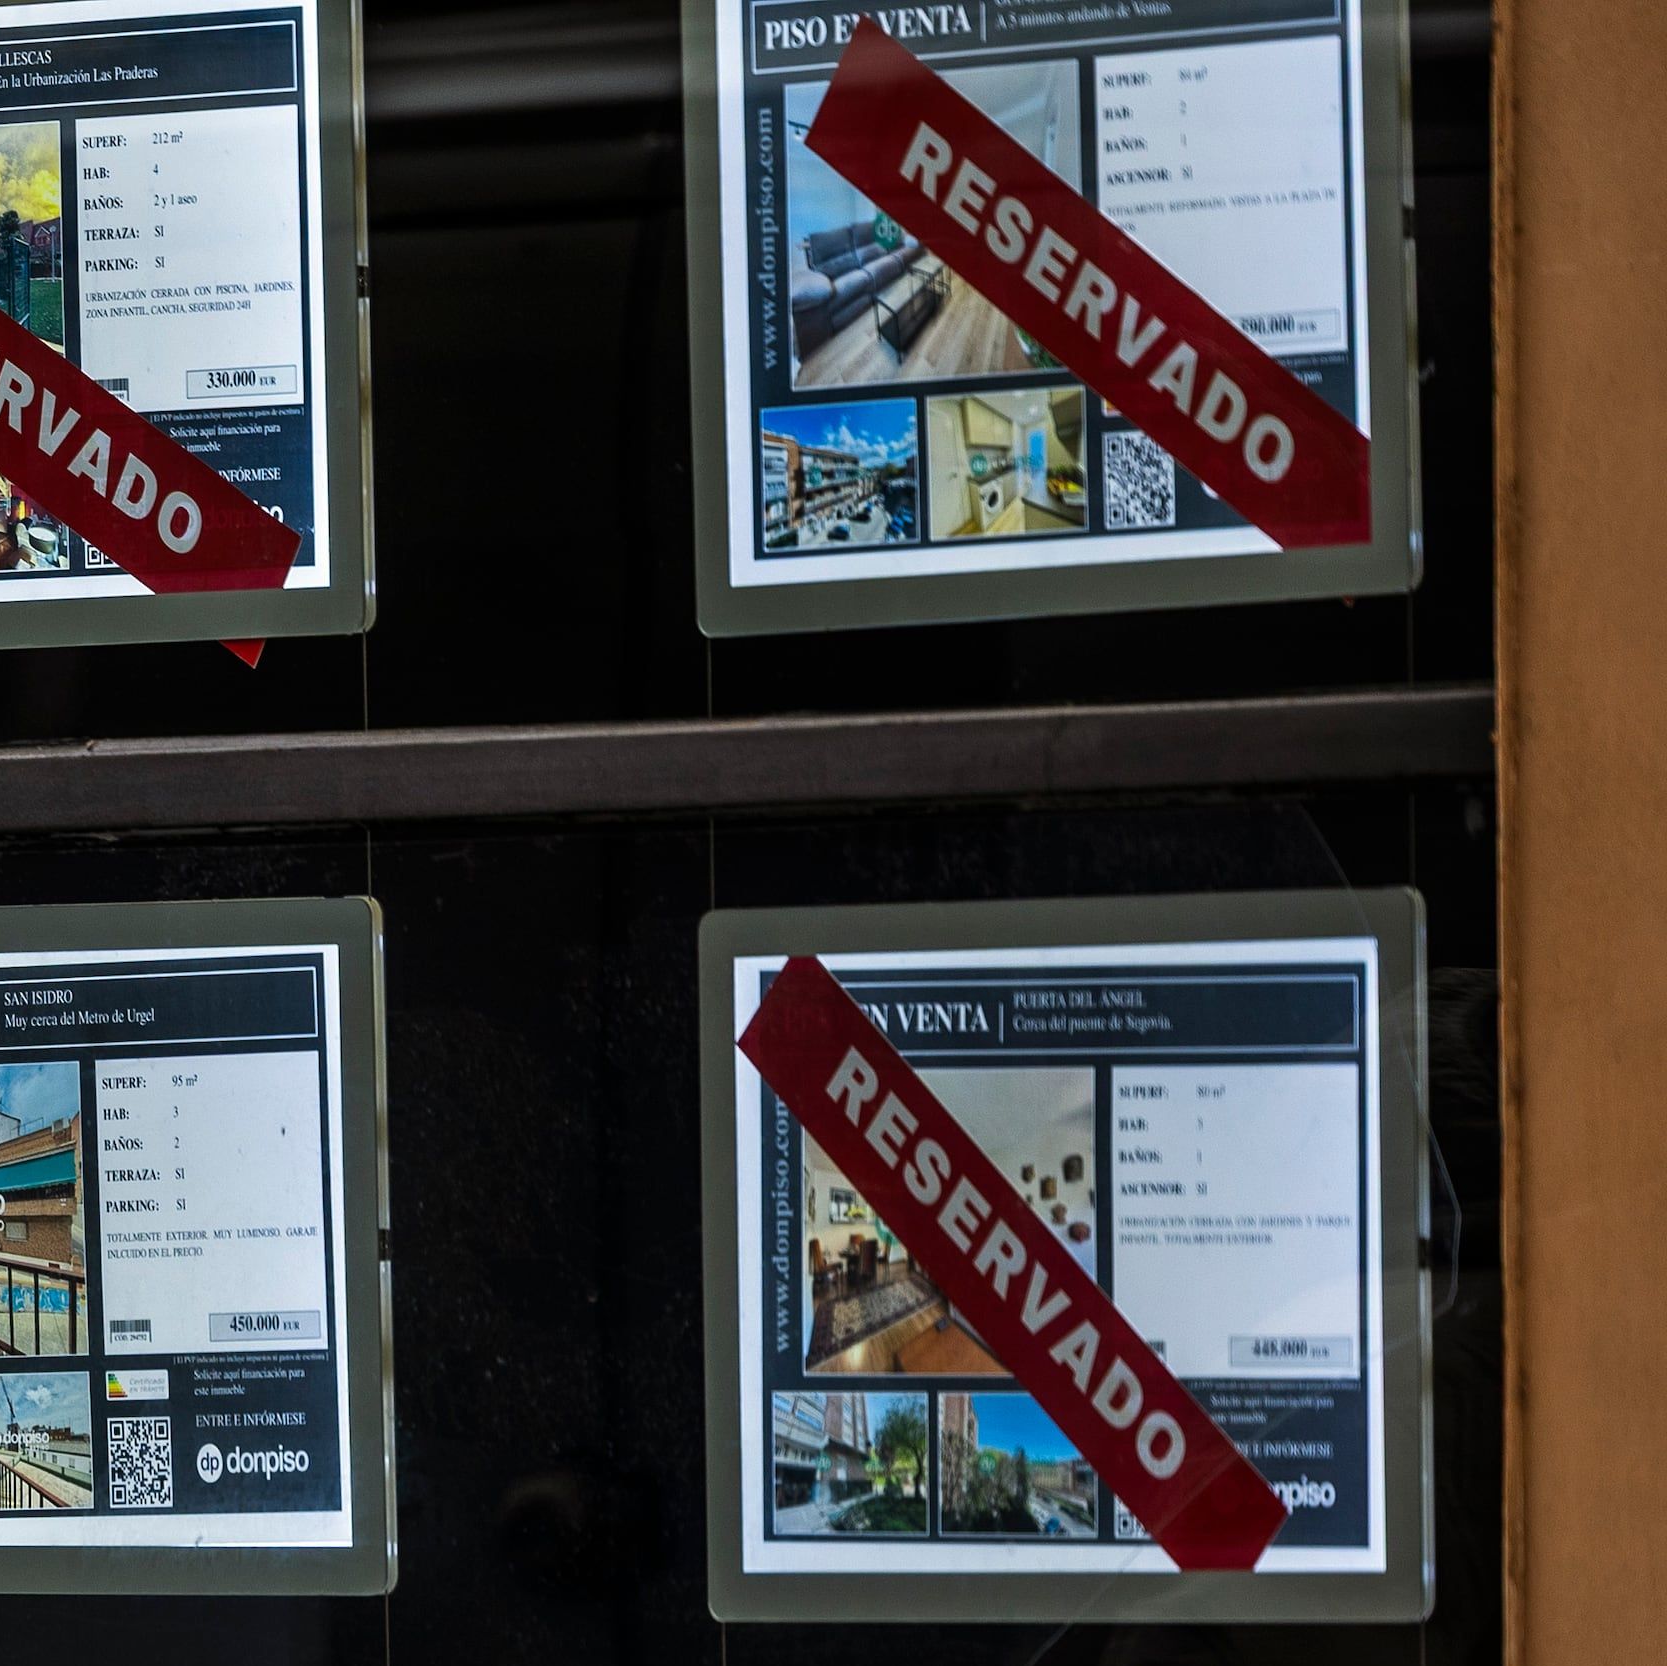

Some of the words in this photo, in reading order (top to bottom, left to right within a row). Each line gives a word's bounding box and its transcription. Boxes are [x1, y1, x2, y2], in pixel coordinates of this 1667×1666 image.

[765, 17, 828, 51] PISO
[10, 73, 22, 88] la
[23, 68, 91, 88] Urbanización
[92, 67, 113, 83] Las
[114, 65, 159, 81] Praderas
[82, 134, 127, 150] SUPERF:
[152, 131, 169, 145] 212
[170, 130, 184, 144] m²
[898, 121, 1296, 484] RESERVADO
[203, 369, 256, 389] 330.000
[4, 991, 29, 1007] SAN
[31, 989, 73, 1005] ISIDRO
[4, 1013, 29, 1032] Muy
[30, 1015, 58, 1027] cerca
[59, 1010, 76, 1026] del
[78, 1010, 110, 1025] Metro
[111, 1008, 125, 1024] de
[126, 1007, 155, 1026] Urgel
[895, 1002, 989, 1033] VENTA
[824, 1045, 1188, 1480] RESERVADO
[229, 1314, 280, 1333] 450.000
[283, 1321, 300, 1331] EUR
[226, 1444, 310, 1481] donpiso
